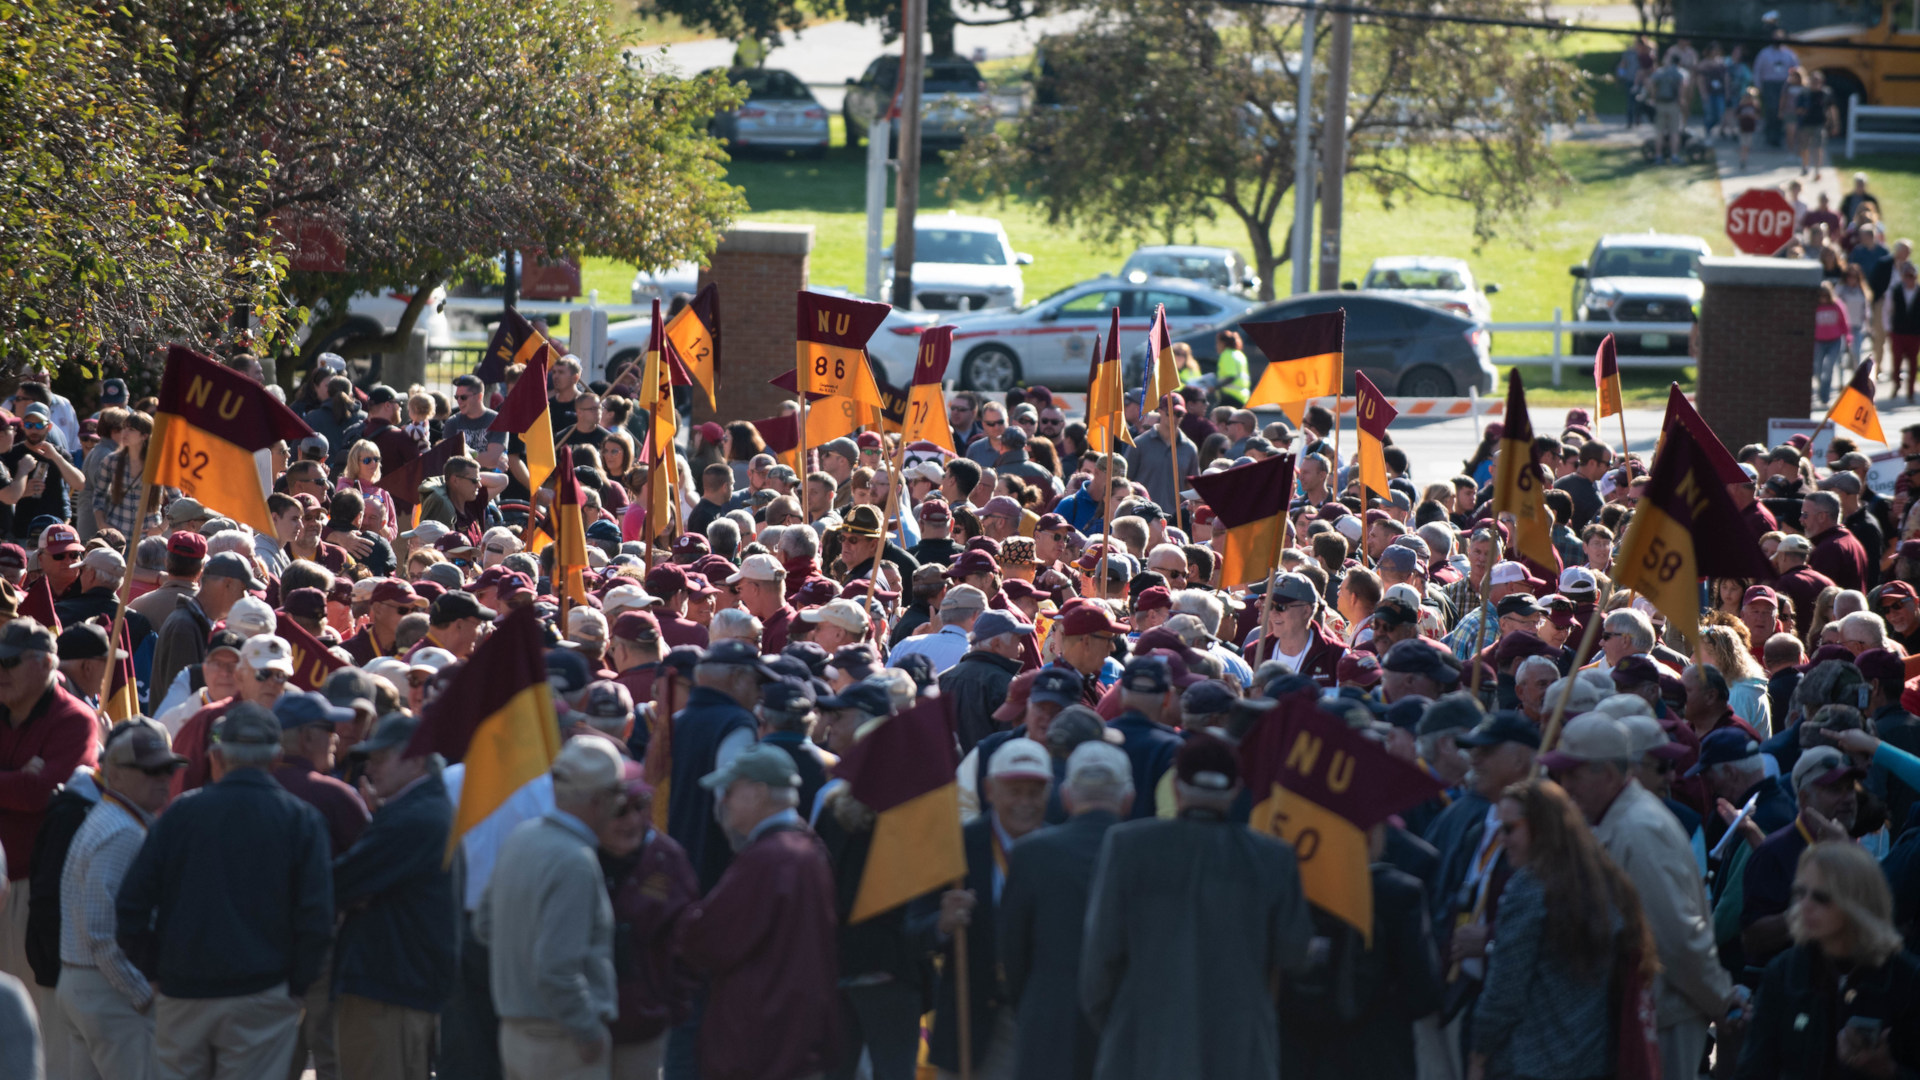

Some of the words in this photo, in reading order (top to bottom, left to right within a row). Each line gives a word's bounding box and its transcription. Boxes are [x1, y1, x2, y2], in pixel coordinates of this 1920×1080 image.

[1729, 207, 1792, 237] STOP
[817, 309, 850, 336] NU
[690, 337, 710, 362] 12
[918, 343, 935, 368] U
[815, 356, 845, 380] 86
[185, 374, 245, 421] NU
[1854, 405, 1869, 425] 04
[178, 441, 209, 480] 62
[1517, 462, 1532, 492] 6
[1869, 470, 1879, 481] O
[1642, 535, 1682, 583] 58
[1285, 730, 1356, 794] NU
